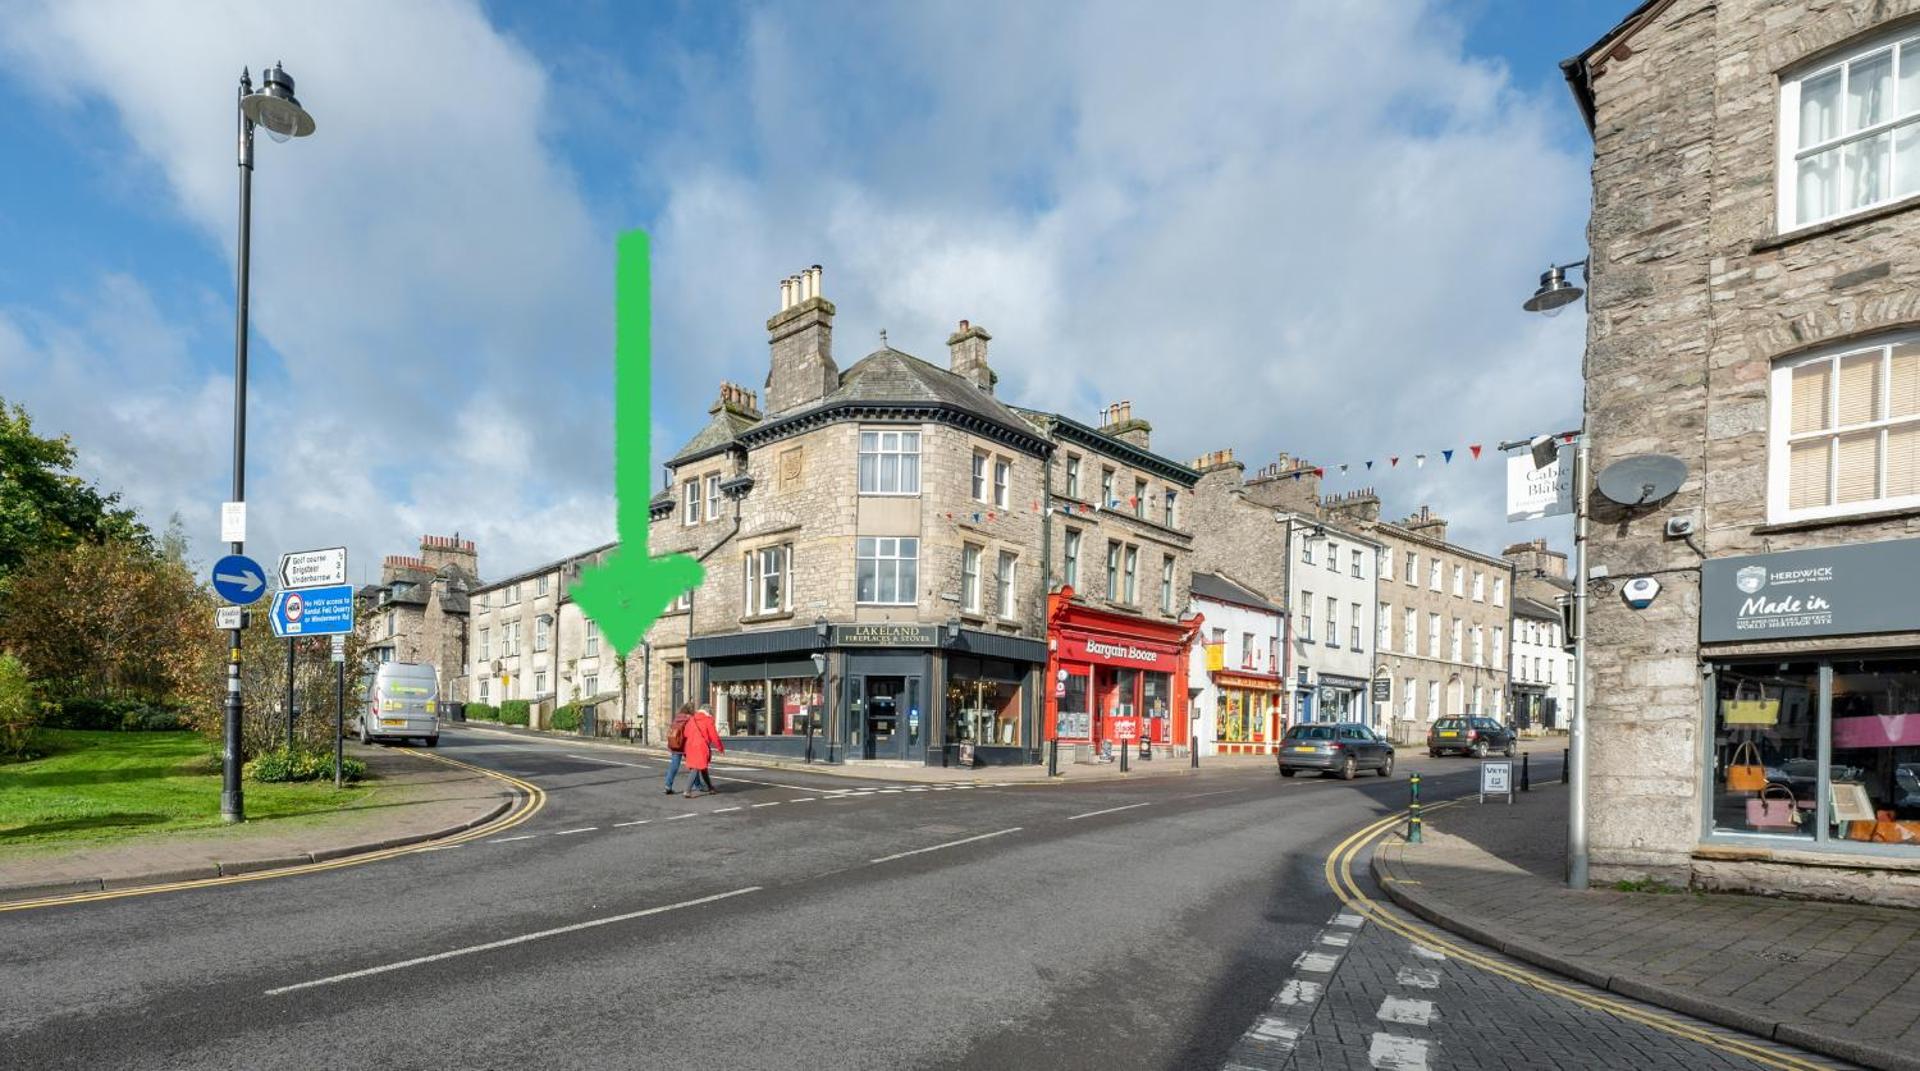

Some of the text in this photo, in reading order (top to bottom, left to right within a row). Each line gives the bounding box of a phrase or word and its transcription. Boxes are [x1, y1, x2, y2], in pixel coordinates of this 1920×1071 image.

[1528, 481, 1571, 496] Blake
[1770, 566, 1833, 581] HERDWICK
[1739, 595, 1831, 617] Made in
[856, 626, 920, 636] LAKELAND
[1086, 640, 1157, 662] Bargain Booze
